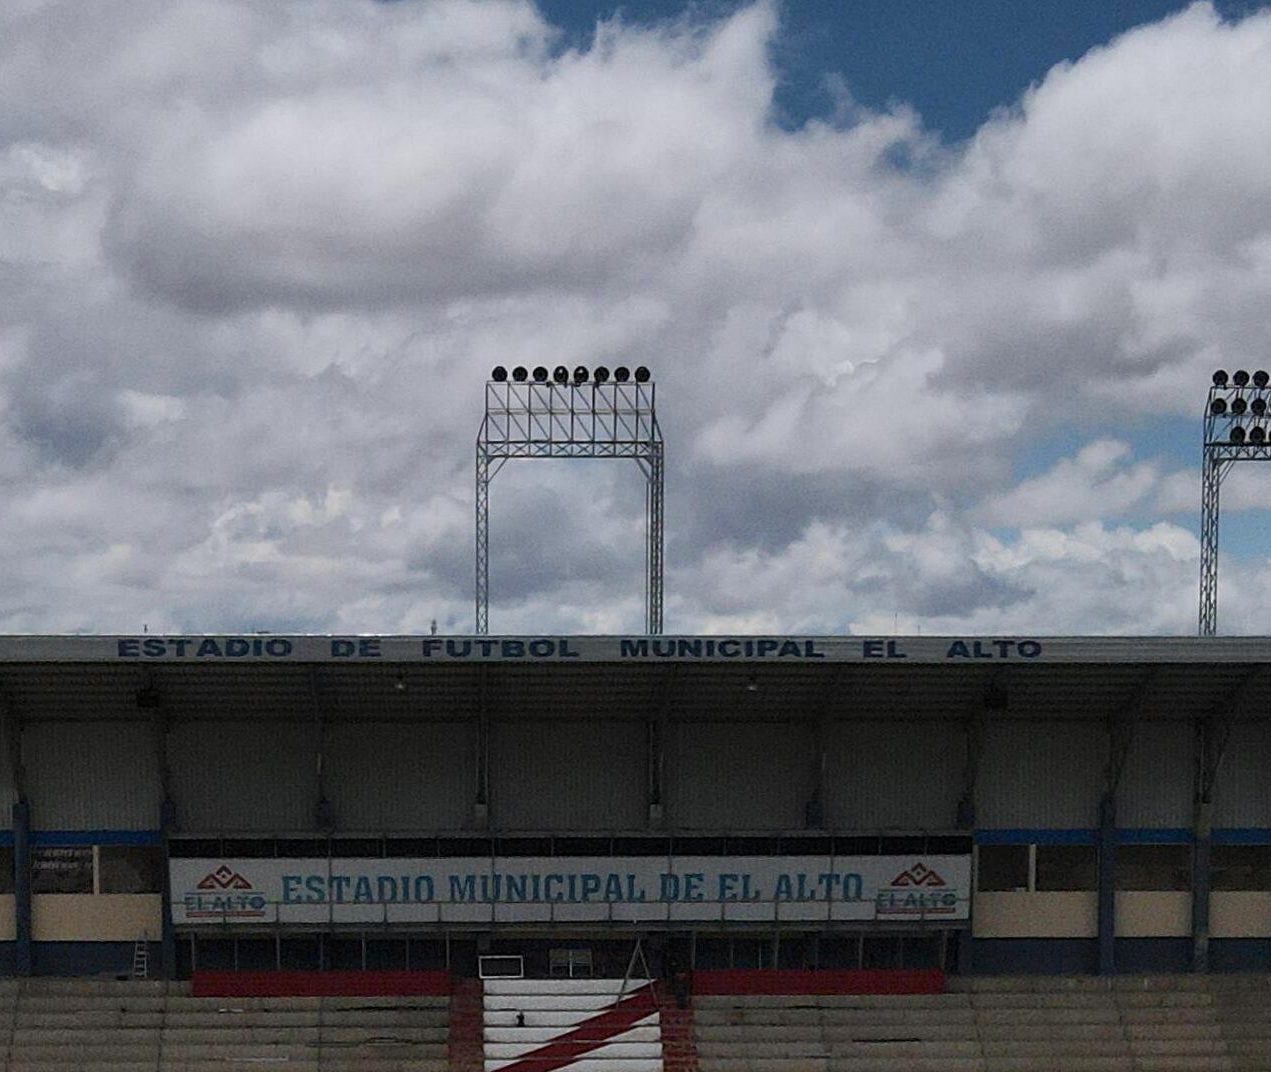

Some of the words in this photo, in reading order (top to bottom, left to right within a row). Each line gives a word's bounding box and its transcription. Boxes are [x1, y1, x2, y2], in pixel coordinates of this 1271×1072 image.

[117, 639, 292, 658] ESTADIO
[331, 639, 382, 658] DE
[422, 639, 579, 658] FUTBOL
[620, 639, 825, 659] MUNICIPAL
[863, 640, 907, 659] EL
[947, 640, 1042, 659] ALTO
[282, 875, 435, 904] ESTADIO
[449, 873, 646, 903] MUNICIPAL
[660, 873, 705, 902] DE
[718, 873, 761, 902] EL
[775, 872, 863, 902] ALTO
